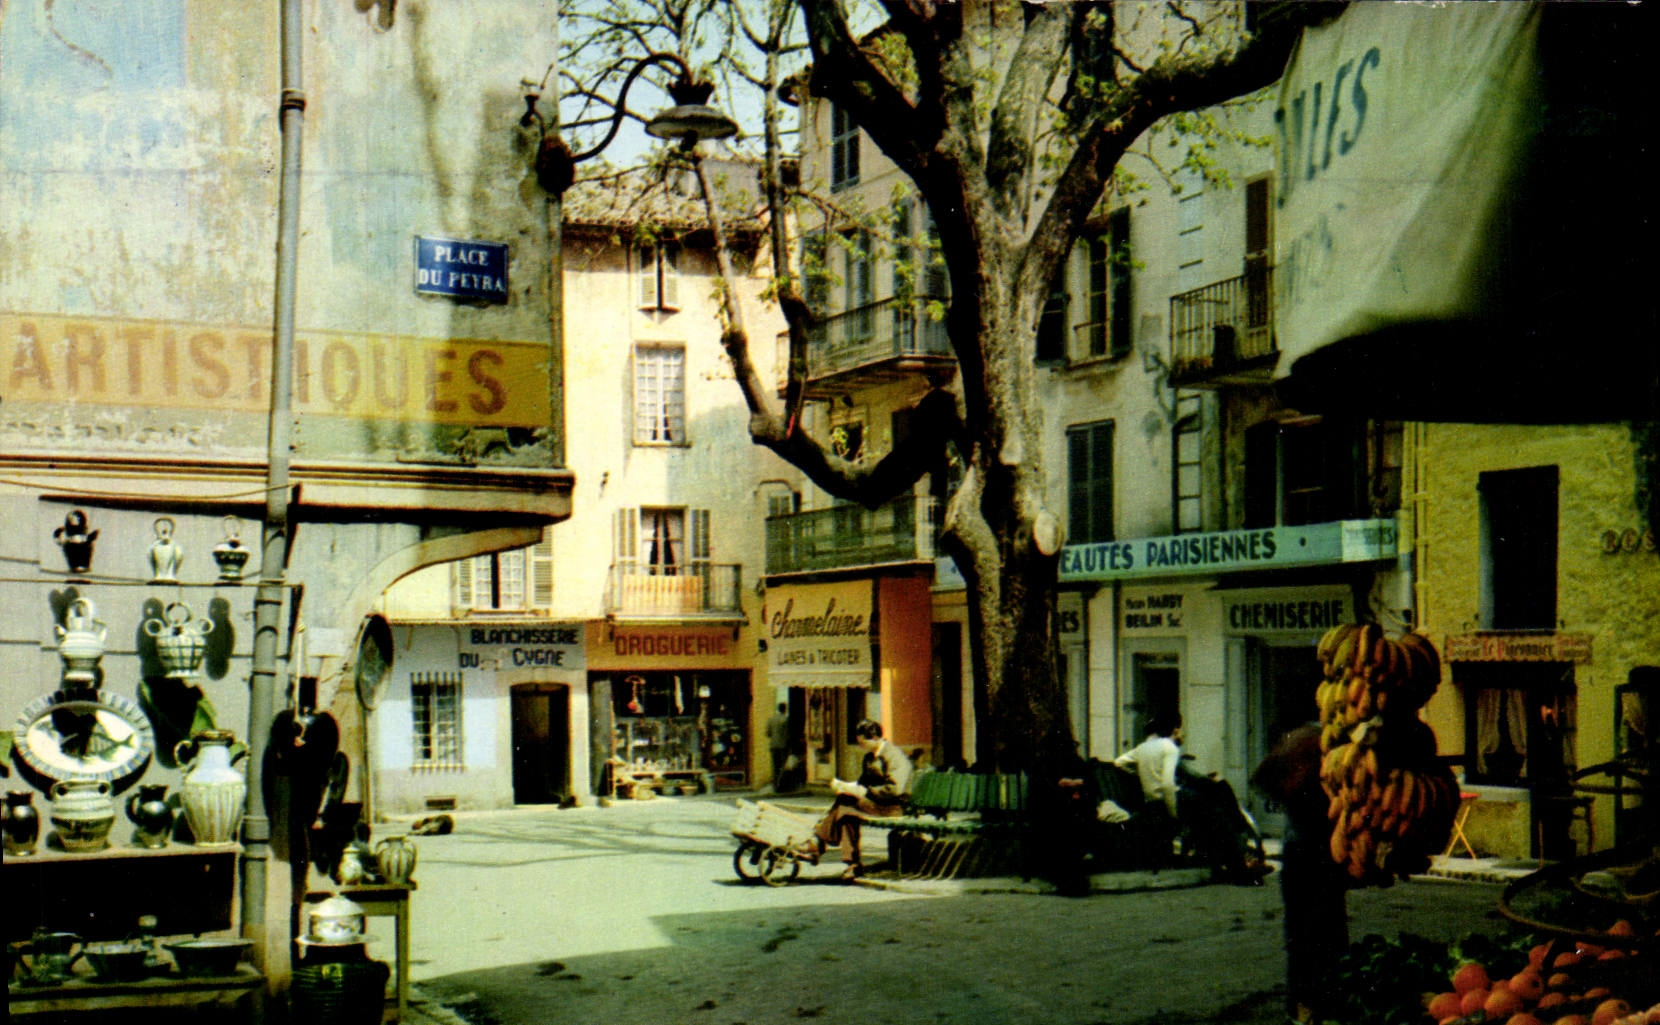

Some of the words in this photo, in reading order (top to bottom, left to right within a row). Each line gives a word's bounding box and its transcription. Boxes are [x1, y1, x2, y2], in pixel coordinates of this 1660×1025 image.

[434, 244, 489, 266] PLACE
[419, 268, 442, 286] DU
[448, 271, 505, 292] PEYRA
[8, 321, 509, 416] ARTISTIQUES
[1146, 531, 1277, 567] PARISIENNES
[1229, 599, 1344, 629] CHEMISERIE
[470, 628, 579, 645] BLANCHISSERIE
[614, 632, 730, 656] DROGUERIE
[459, 652, 480, 668] DU
[512, 647, 566, 667] CYGNE
[817, 648, 860, 666] TRICOTER
